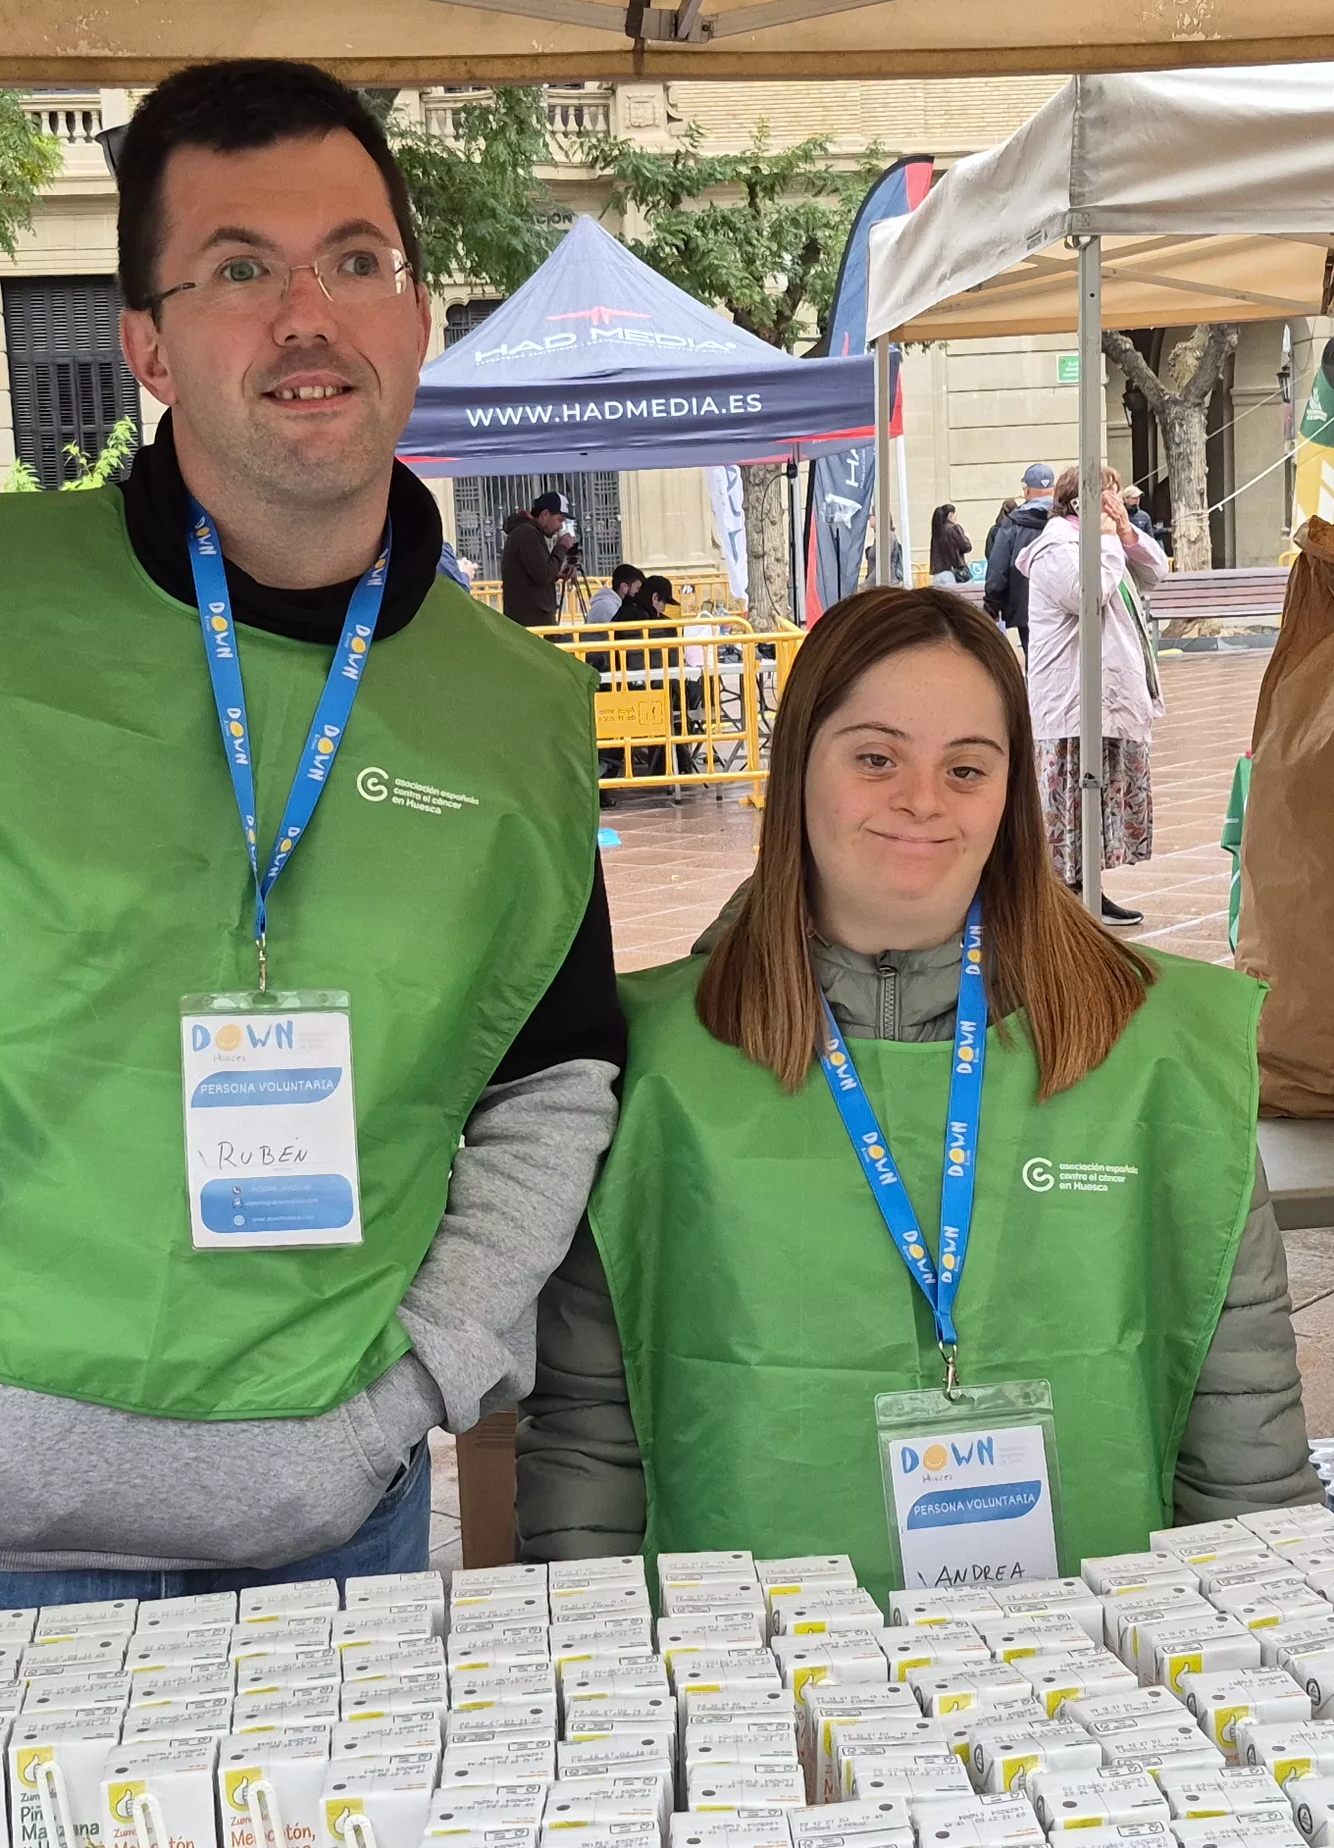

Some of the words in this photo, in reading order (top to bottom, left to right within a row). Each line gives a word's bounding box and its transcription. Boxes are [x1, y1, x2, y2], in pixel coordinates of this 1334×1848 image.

[475, 332, 577, 363] HAD
[590, 327, 729, 351] MEDIA
[465, 393, 763, 428] WWW.HADMEDIA.ES
[208, 601, 234, 659] DOWN
[342, 624, 372, 681] DOWN
[226, 706, 249, 766] DOWN
[307, 724, 340, 783] DOWN
[391, 796, 405, 806] en
[405, 799, 442, 815] Huesca
[393, 787, 422, 801] contra
[431, 796, 463, 809] cáncer
[394, 777, 440, 796] asociación
[440, 789, 480, 805] española
[267, 826, 301, 878] DOWN
[966, 924, 983, 976] DOWN
[191, 1020, 294, 1053] DOWN
[956, 1020, 978, 1076] DOWN
[200, 1083, 256, 1095] PERSONA
[258, 1079, 335, 1093] VOLUNTARIA
[862, 1131, 898, 1187] DOWN
[947, 1121, 970, 1178] DOWN
[1059, 1163, 1104, 1172] asociación
[1105, 1164, 1139, 1175] española
[1059, 1172, 1088, 1181] contra
[1089, 1173, 1097, 1181] el
[1098, 1174, 1126, 1183] cáncer
[1059, 1182, 1072, 1190] en
[1073, 1181, 1109, 1192] Huesca
[902, 1230, 937, 1285] DOWN
[941, 1225, 961, 1284] DOWN
[901, 1435, 994, 1474] DOWN
[913, 1501, 965, 1516] PERSONA
[966, 1494, 1036, 1511] VOLUNTARIA
[934, 1561, 1025, 1588] ANDREA
[20, 1792, 41, 1802] Zum
